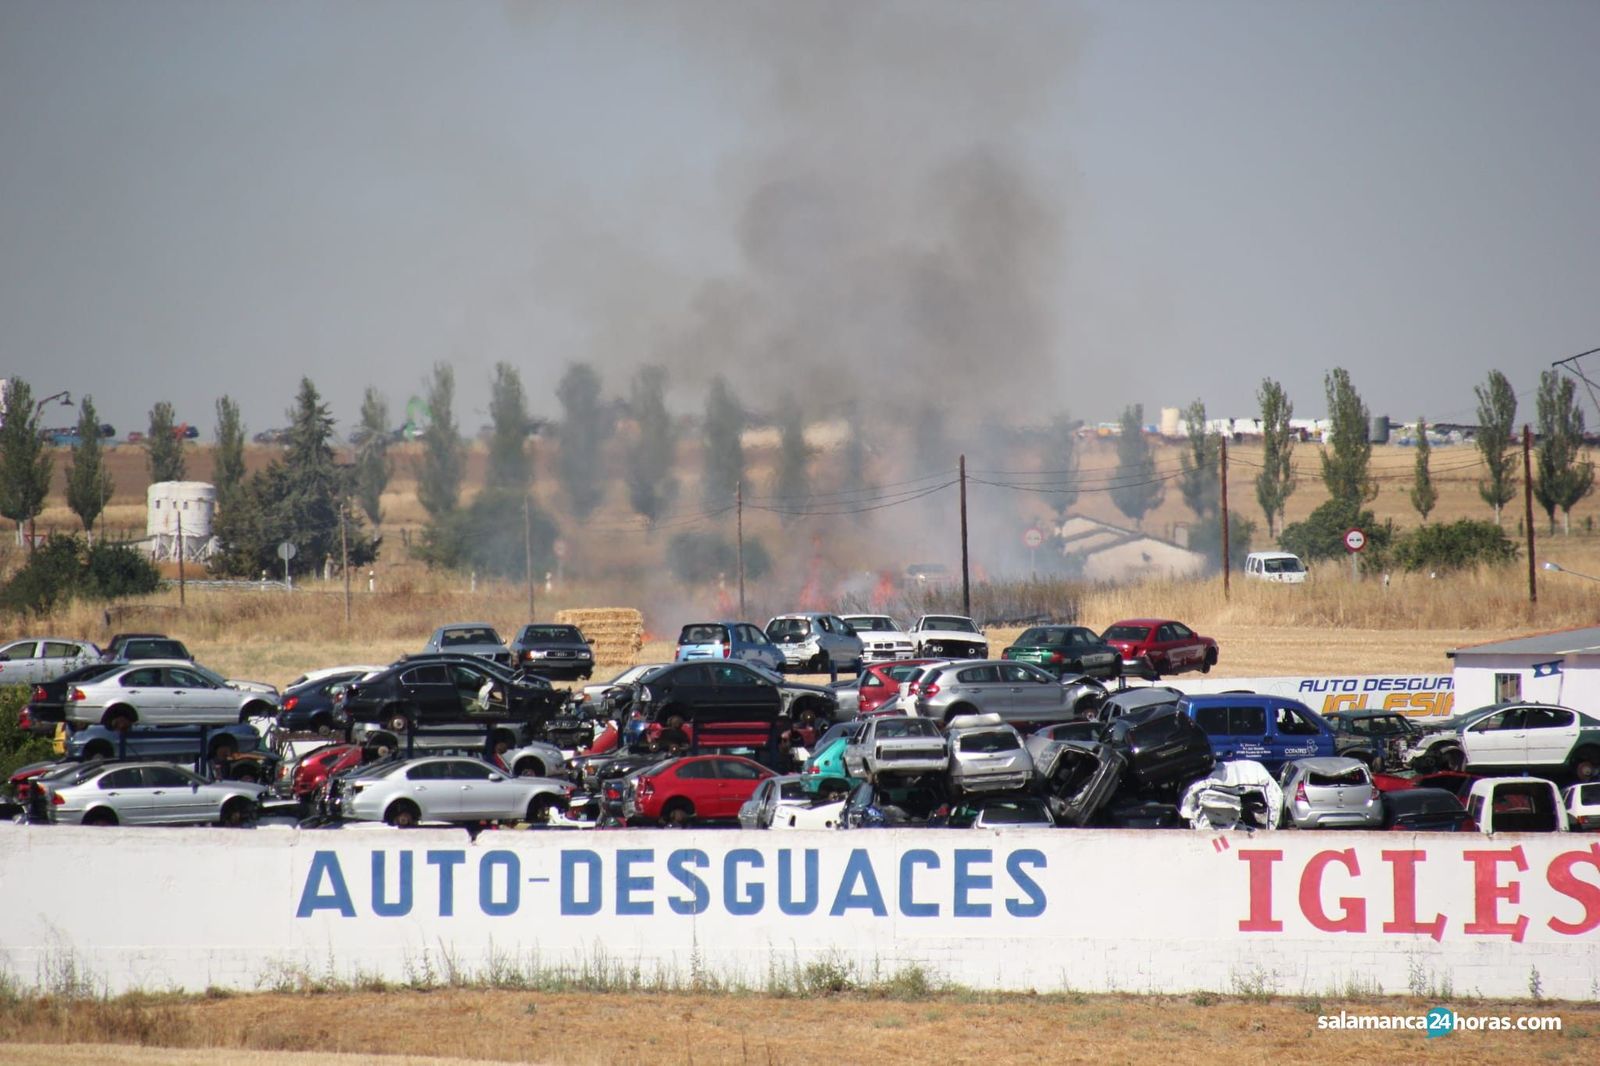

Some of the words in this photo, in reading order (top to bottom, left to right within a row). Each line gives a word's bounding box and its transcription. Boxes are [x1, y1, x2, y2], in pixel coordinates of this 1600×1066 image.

[1299, 680, 1358, 692] AUTO
[1363, 677, 1454, 691] DESGUA
[296, 848, 1048, 918] AUTO-DESGUACES
